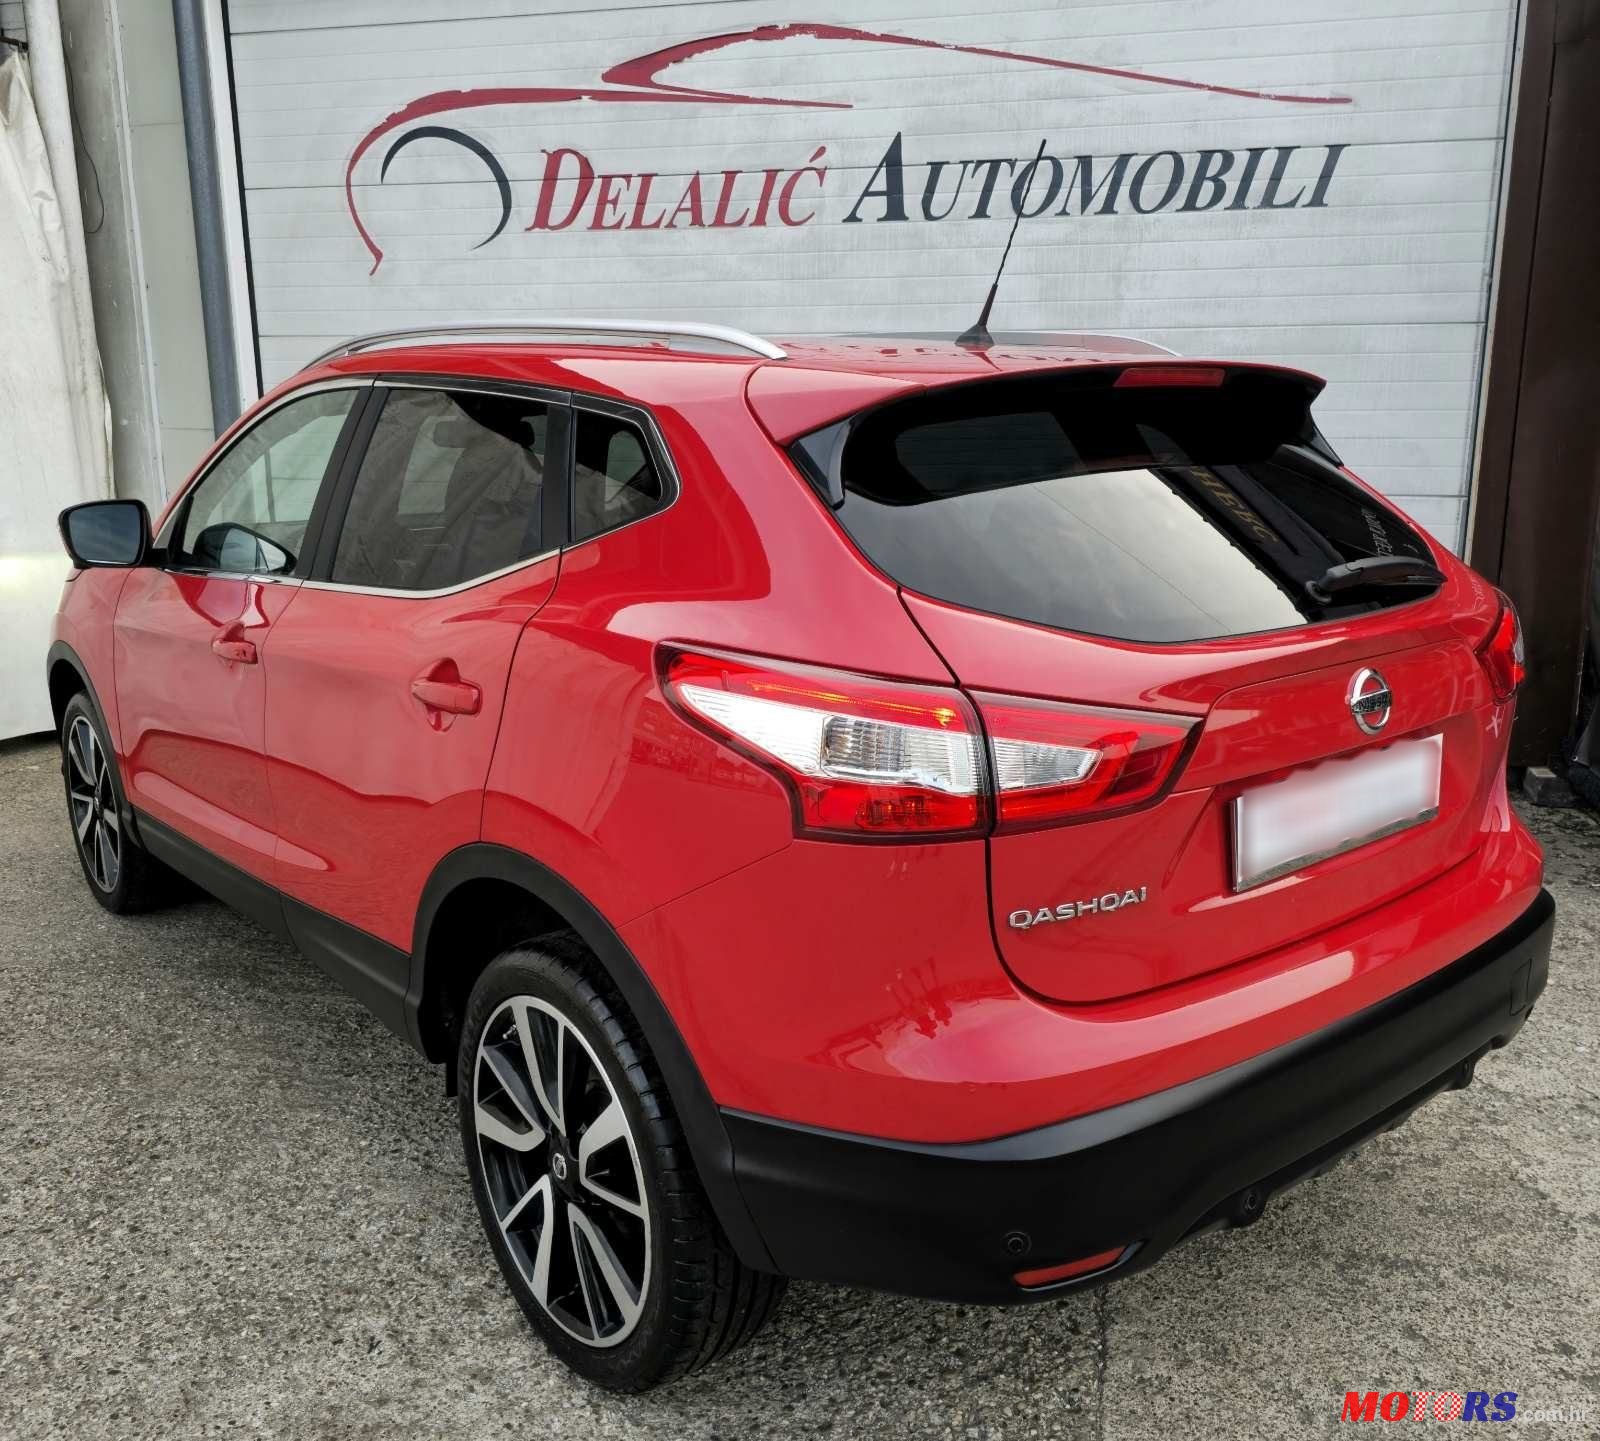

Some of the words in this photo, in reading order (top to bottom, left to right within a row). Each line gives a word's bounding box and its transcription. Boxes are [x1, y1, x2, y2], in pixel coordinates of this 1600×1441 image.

[525, 145, 828, 232] DELALIĆ
[841, 130, 1351, 224] AUTOMOBILI
[1008, 885, 1148, 930] QASHQAI
